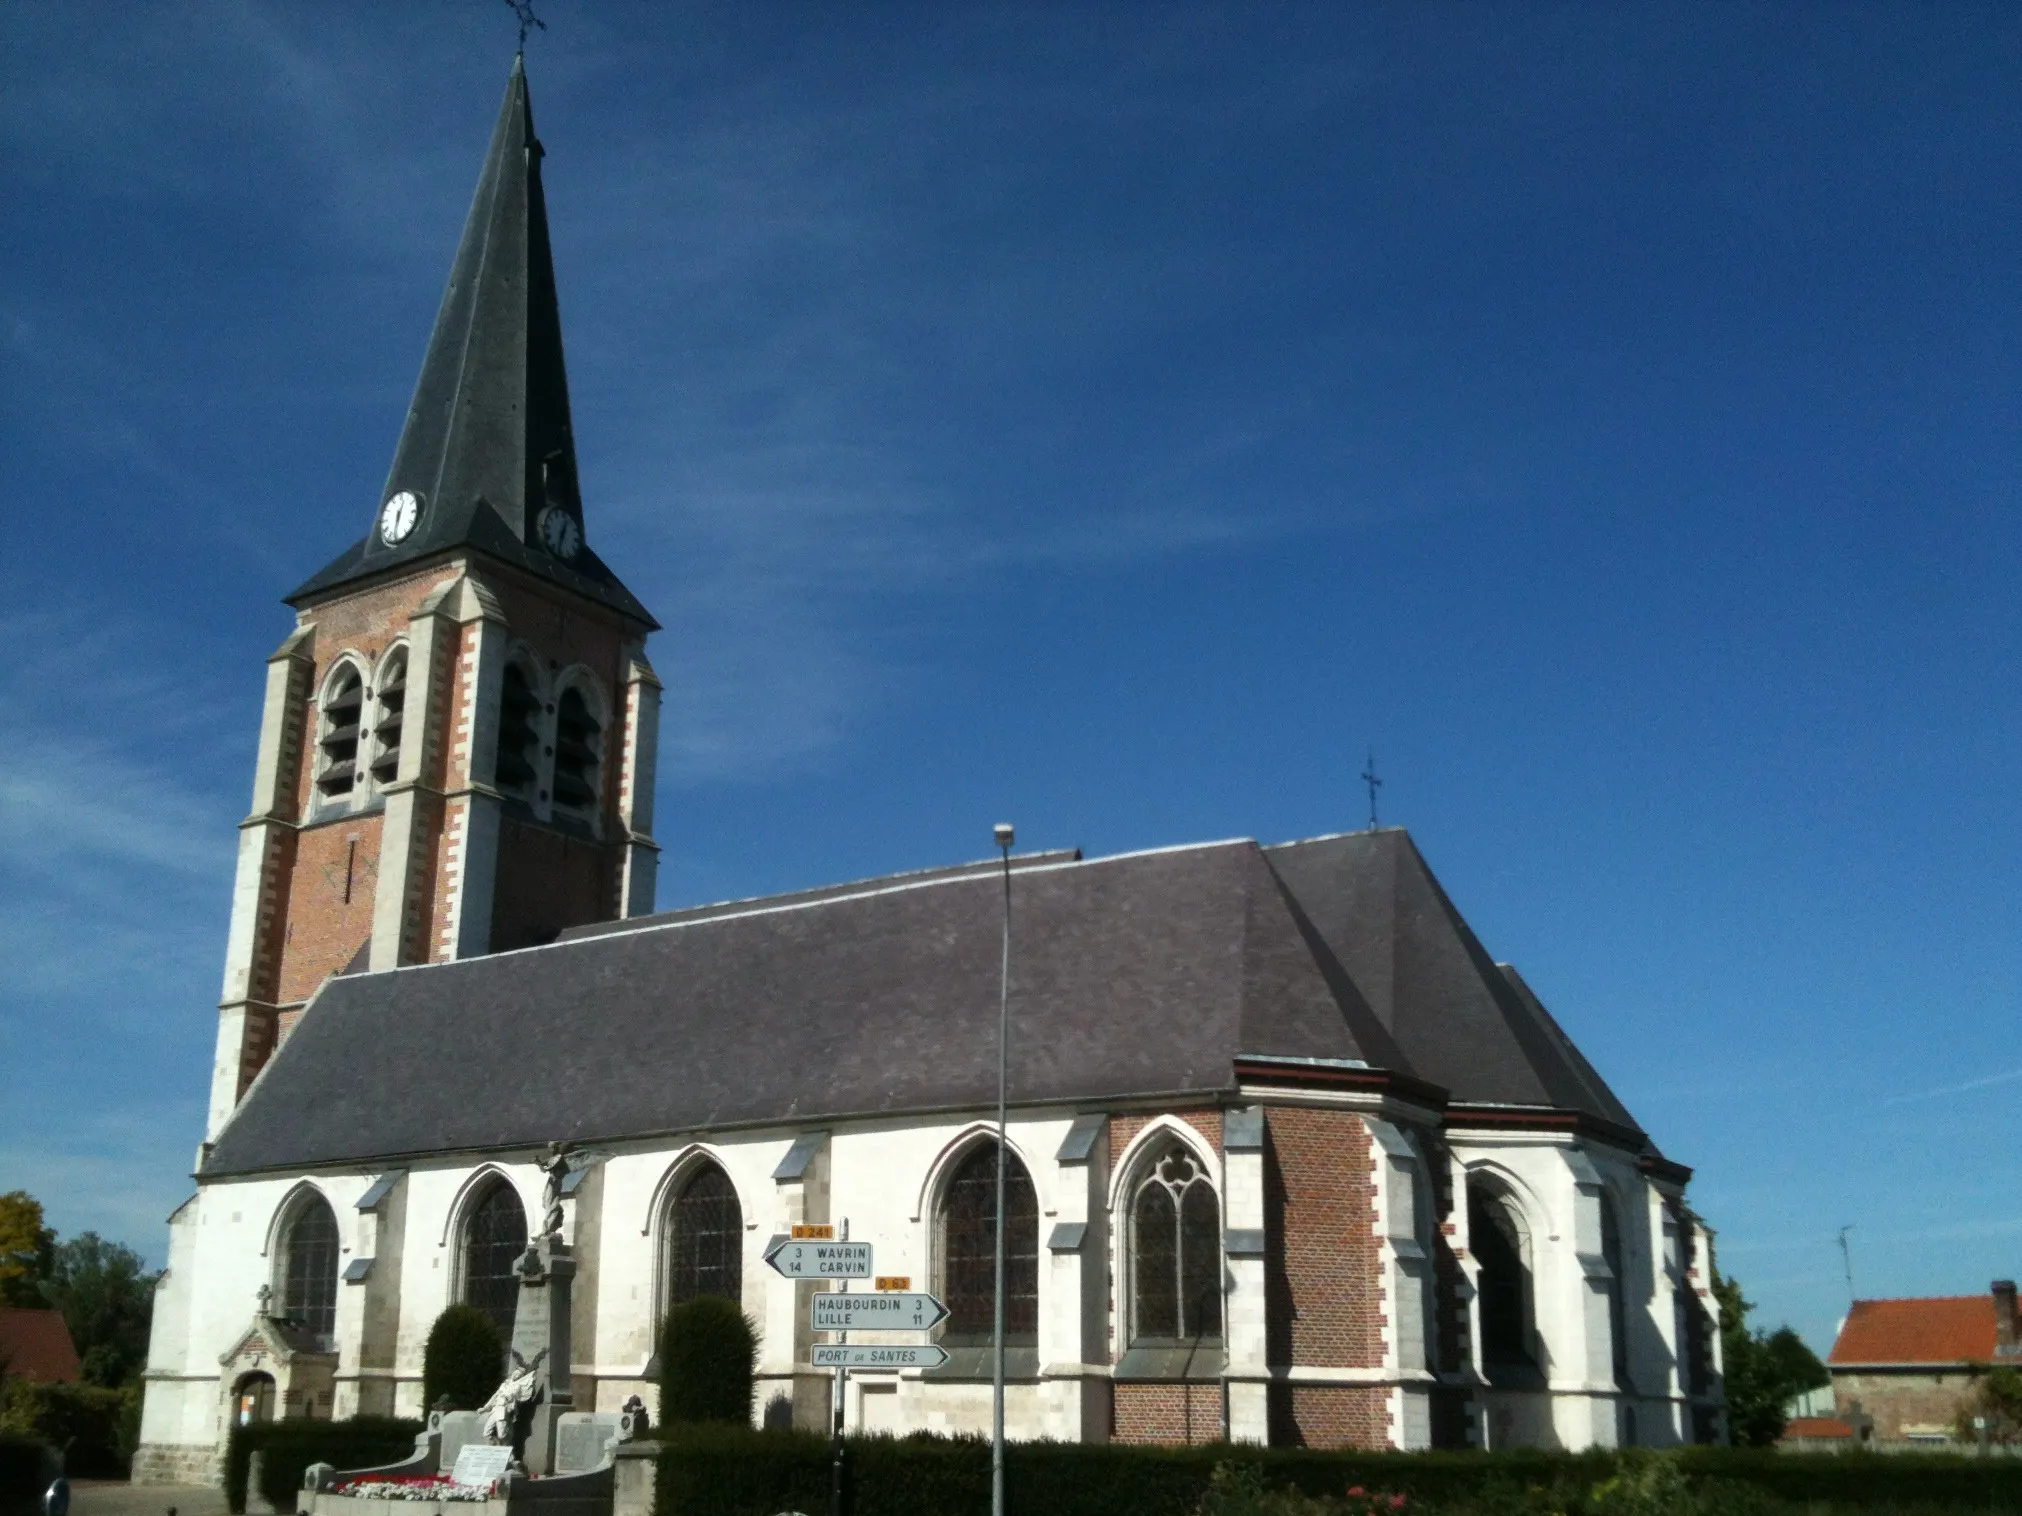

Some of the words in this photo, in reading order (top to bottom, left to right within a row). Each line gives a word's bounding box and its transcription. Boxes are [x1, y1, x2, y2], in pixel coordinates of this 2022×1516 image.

[796, 1248, 802, 1258] 3
[817, 1248, 866, 1258] WAVRIN
[790, 1262, 802, 1272] 14
[819, 1262, 865, 1273] CARVIN
[818, 1299, 901, 1310] HAUBOURDIN
[916, 1300, 922, 1310] 3
[818, 1314, 852, 1325] LILLE
[914, 1314, 922, 1324] 11
[818, 1350, 849, 1362] PORT
[870, 1350, 916, 1362] SANTES
